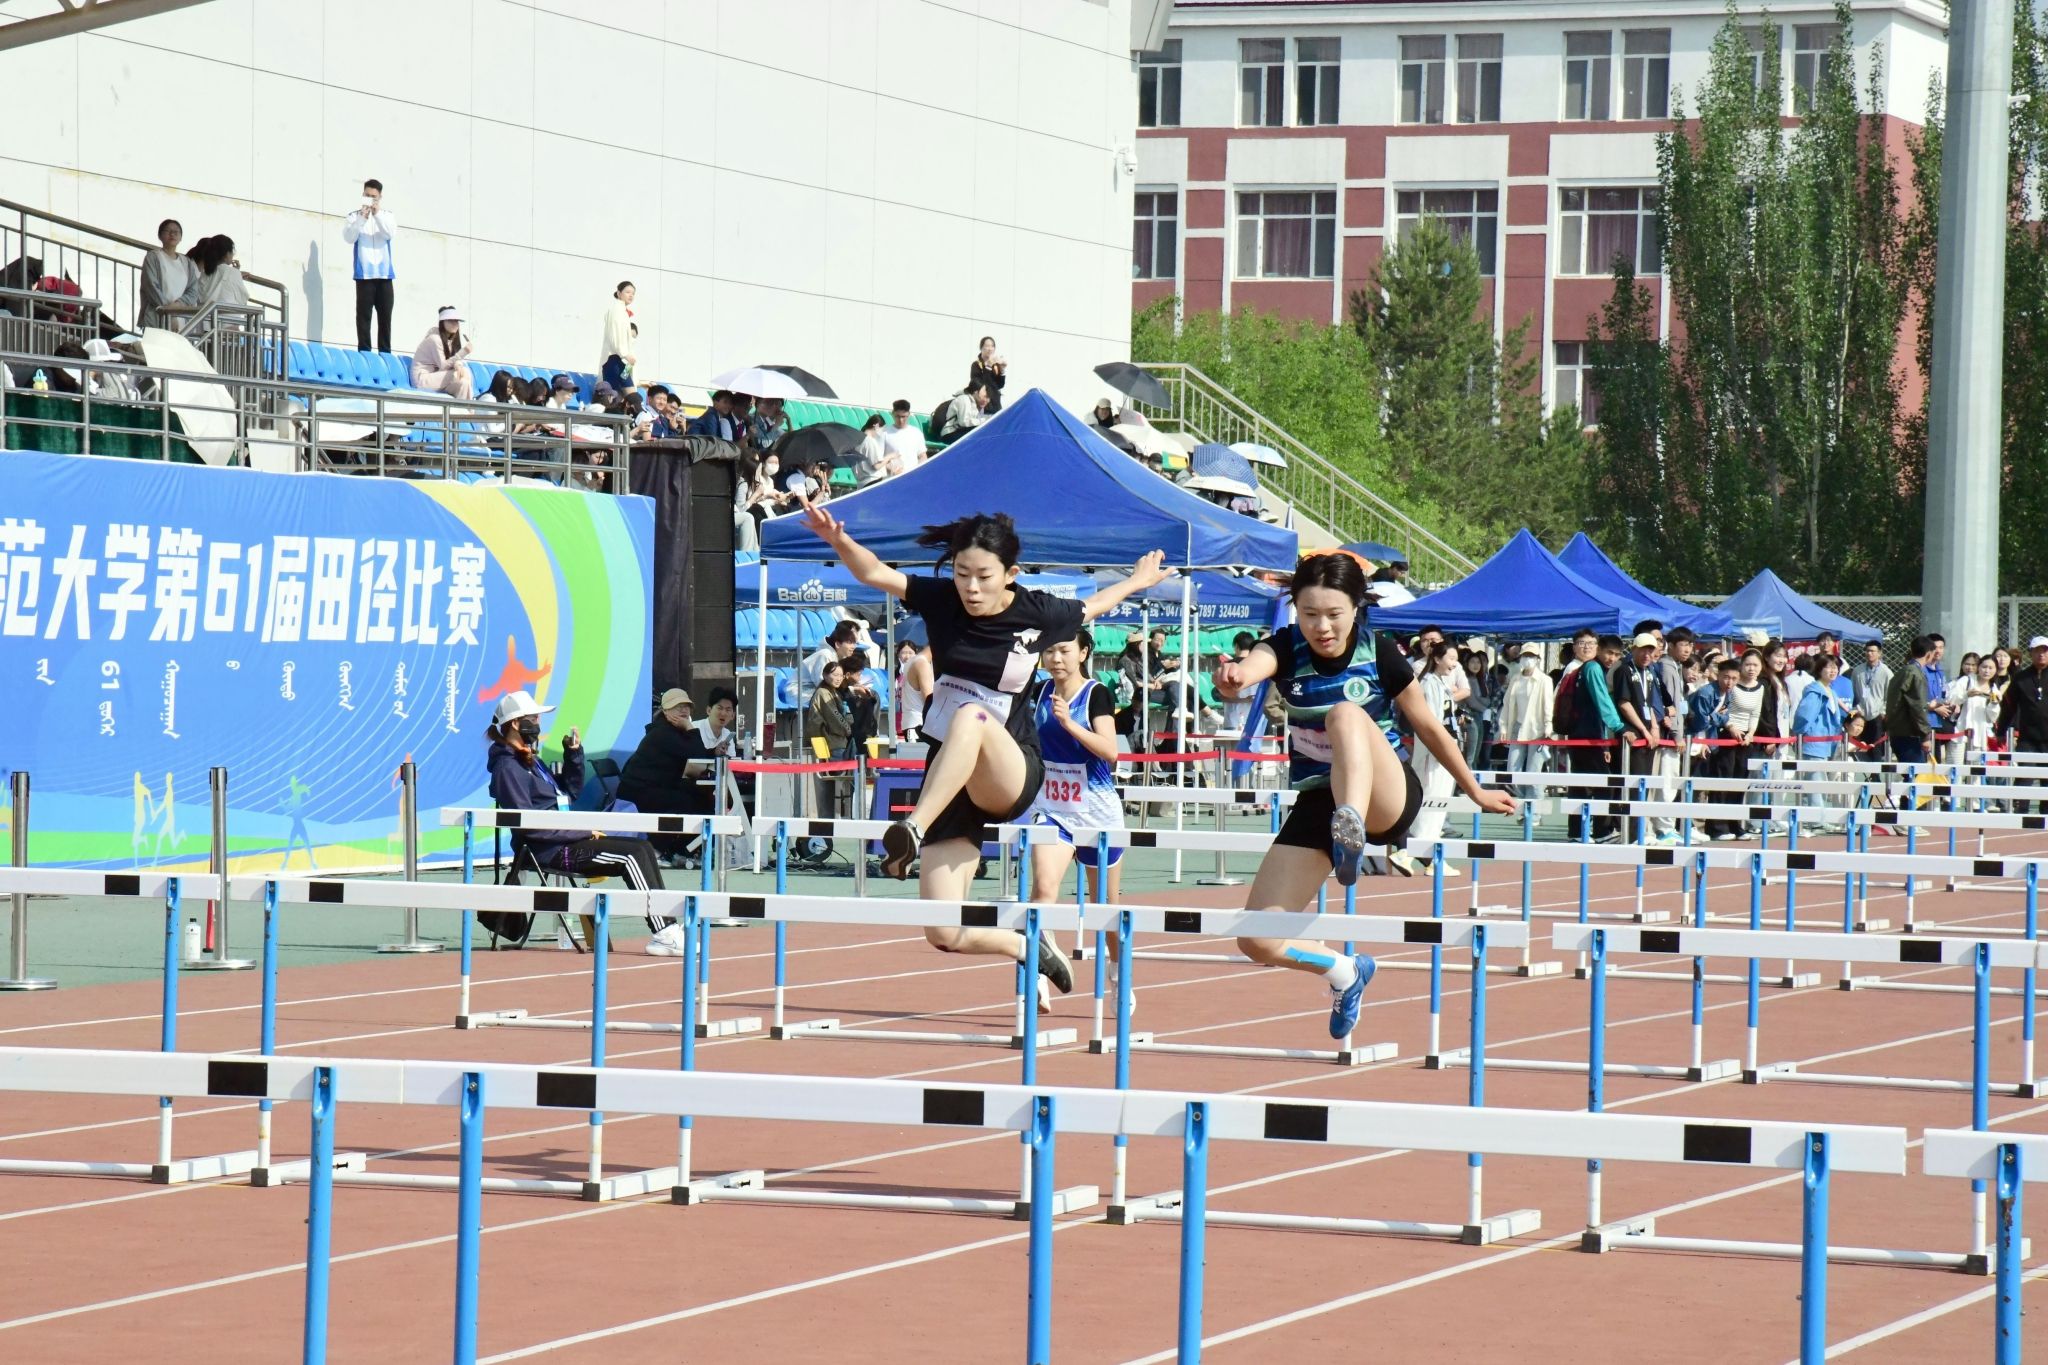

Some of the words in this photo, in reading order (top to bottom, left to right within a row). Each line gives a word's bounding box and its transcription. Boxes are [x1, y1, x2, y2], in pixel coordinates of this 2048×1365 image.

[0, 518, 486, 645] 范大学第61届田径比赛
[1218, 605, 1250, 618] 3244430
[1045, 780, 1081, 802] 1332
